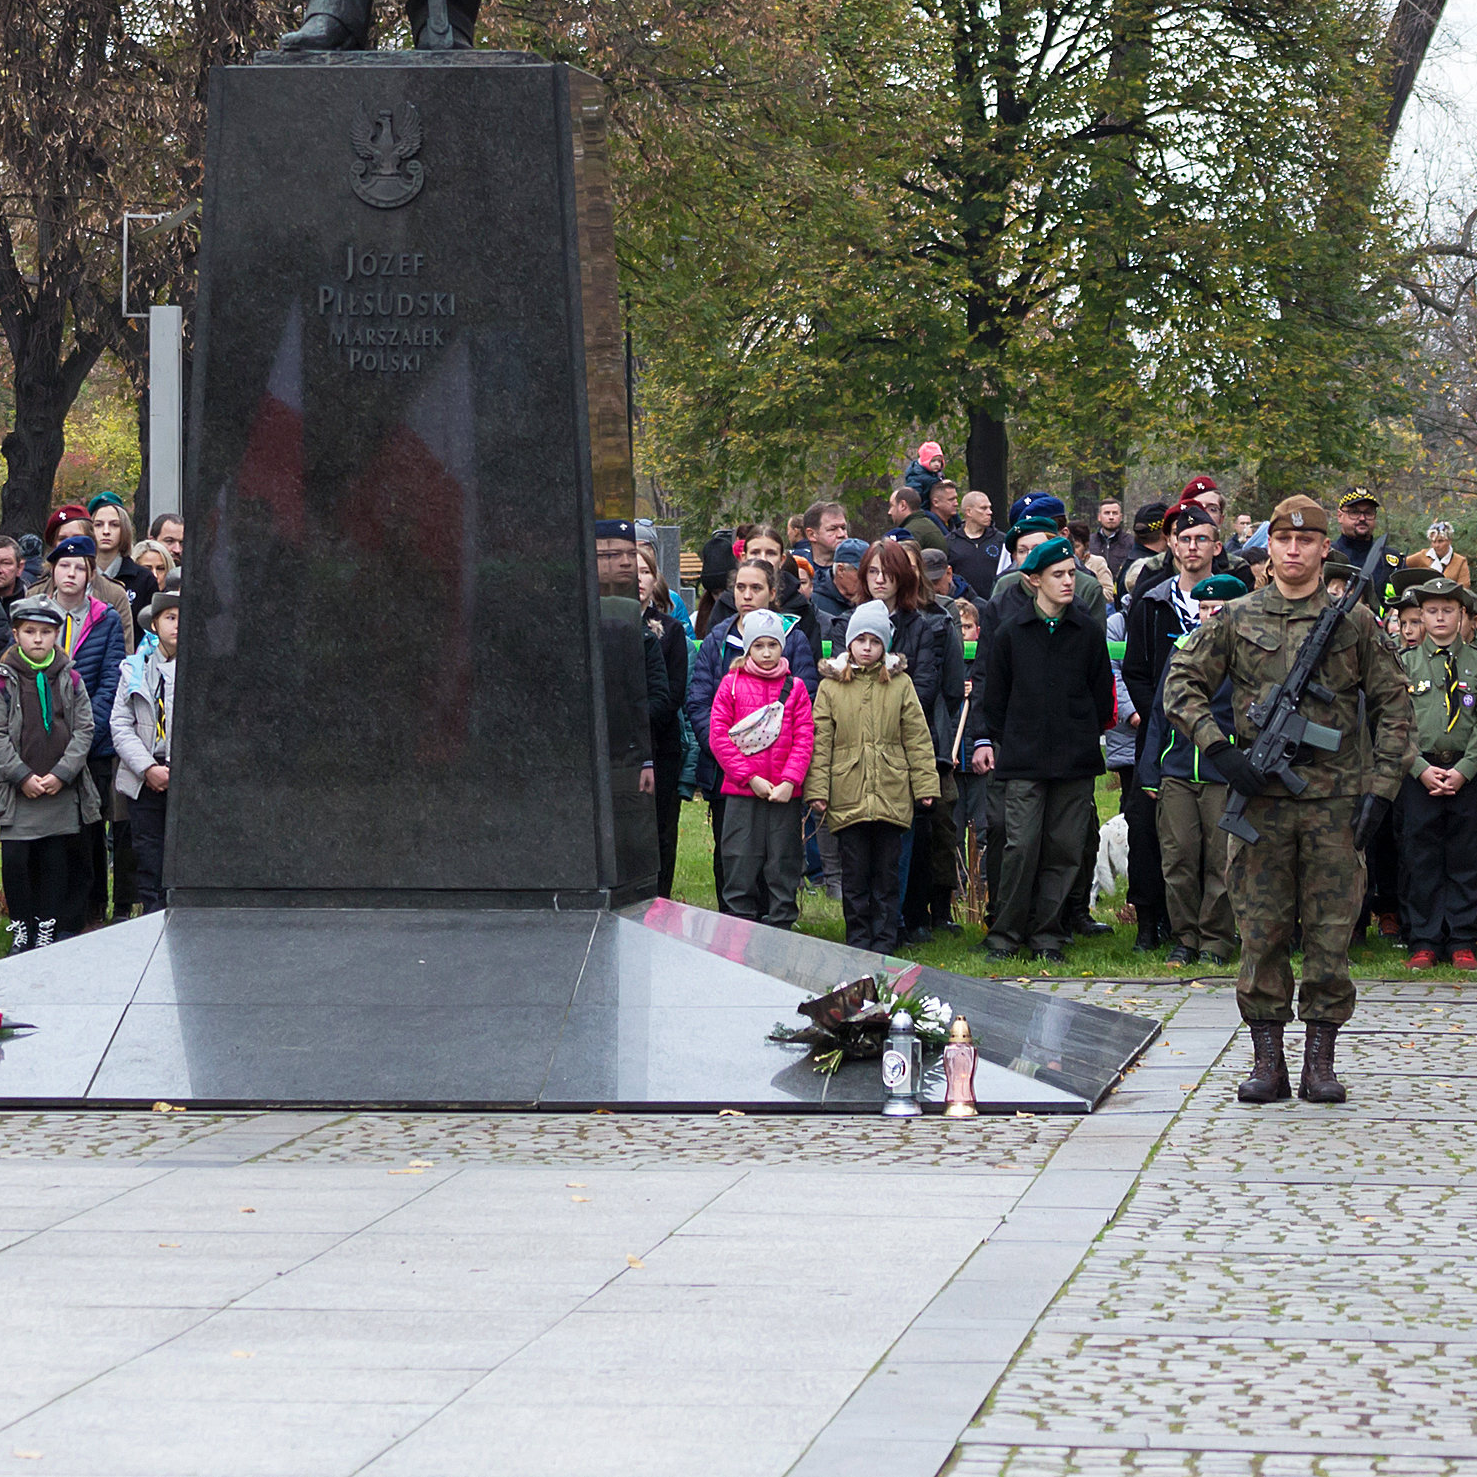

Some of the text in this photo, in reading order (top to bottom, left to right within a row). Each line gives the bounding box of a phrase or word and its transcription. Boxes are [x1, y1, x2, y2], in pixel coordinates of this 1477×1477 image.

[345, 246, 424, 281] JÓZEF
[318, 286, 455, 316] PIŁSUDSKI
[329, 325, 444, 346] MARSZAŁEK
[350, 349, 421, 371] POLSKI
